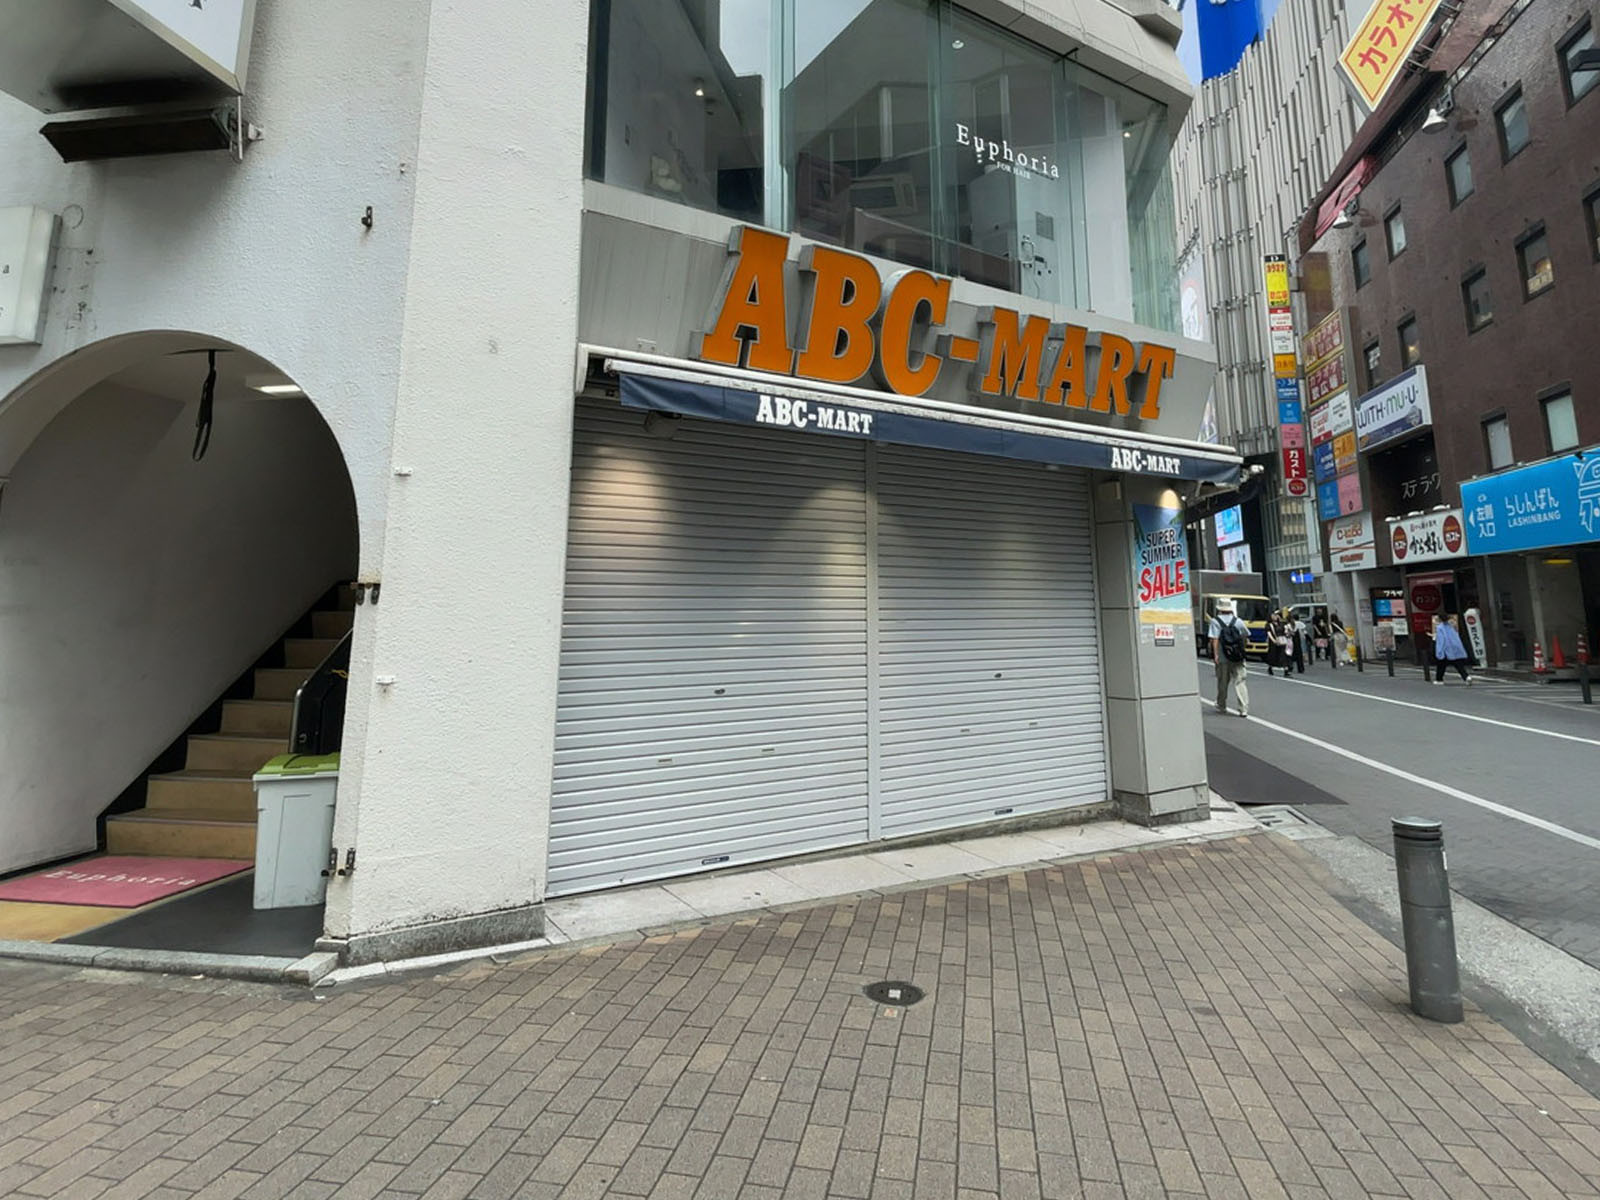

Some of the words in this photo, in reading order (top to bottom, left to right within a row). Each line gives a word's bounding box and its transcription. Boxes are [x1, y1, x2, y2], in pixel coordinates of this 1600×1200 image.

[1357, 0, 1424, 75] カラオ
[955, 122, 1060, 179] Euphoria
[700, 225, 1177, 420] ABC-MART
[755, 394, 873, 435] ABC-MART
[1111, 446, 1181, 475] ABC-MART
[1288, 450, 1300, 478] ガスト
[1504, 487, 1560, 517] らしんばん
[1478, 521, 1497, 538] 入口
[1507, 510, 1562, 528] LASHINBANG
[1146, 527, 1176, 548] SUPER
[1141, 543, 1183, 566] SUMMER
[1139, 560, 1187, 602] SALE
[45, 869, 196, 887] Euphoria
